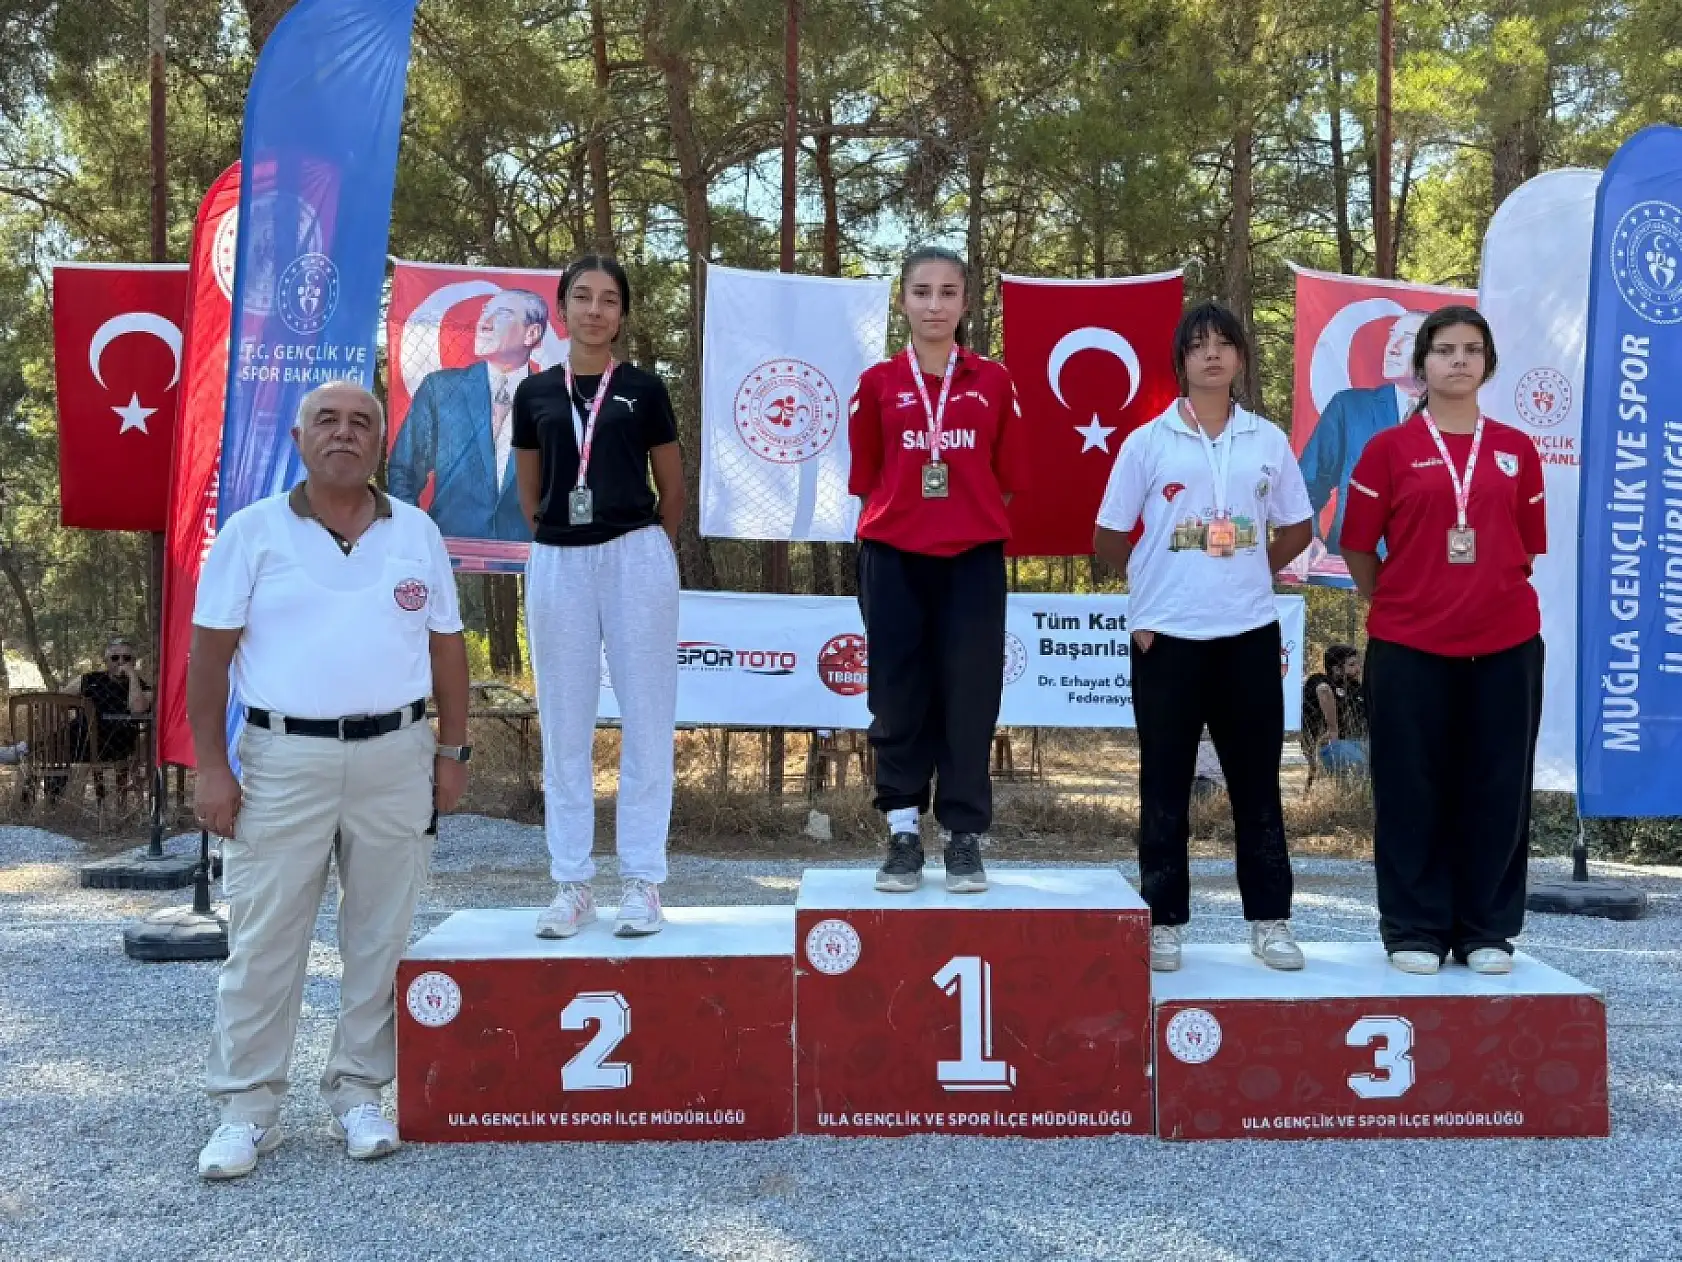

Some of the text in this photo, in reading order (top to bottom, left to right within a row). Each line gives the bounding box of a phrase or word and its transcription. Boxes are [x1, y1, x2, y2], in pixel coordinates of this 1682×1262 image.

[273, 342, 338, 364] GENÇLİK
[345, 346, 367, 363] VE
[242, 365, 280, 382] SPOR
[1602, 334, 1650, 752] MUĞLA GENÇLİK VE SPOR
[1032, 612, 1127, 631] Tüm Kat
[1039, 637, 1129, 661] Başarıla
[1038, 674, 1056, 687] Dr.
[1060, 674, 1111, 691] Erhayat
[932, 956, 1016, 1092] 1
[560, 990, 633, 1092] 2
[1345, 1015, 1415, 1099] 3
[448, 1108, 746, 1129] ULA GENÇLİK VE SPOR İLÇE MÜDÜRLÜĞÜ
[818, 1109, 1132, 1129] ULA GENÇLİK VE SPOR İLÇE MÜDÜRLÜĞÜ
[1241, 1110, 1524, 1130] ULA GENÇLİK VE SPOR İLÇE MÜDÜRLÜĞÜ
